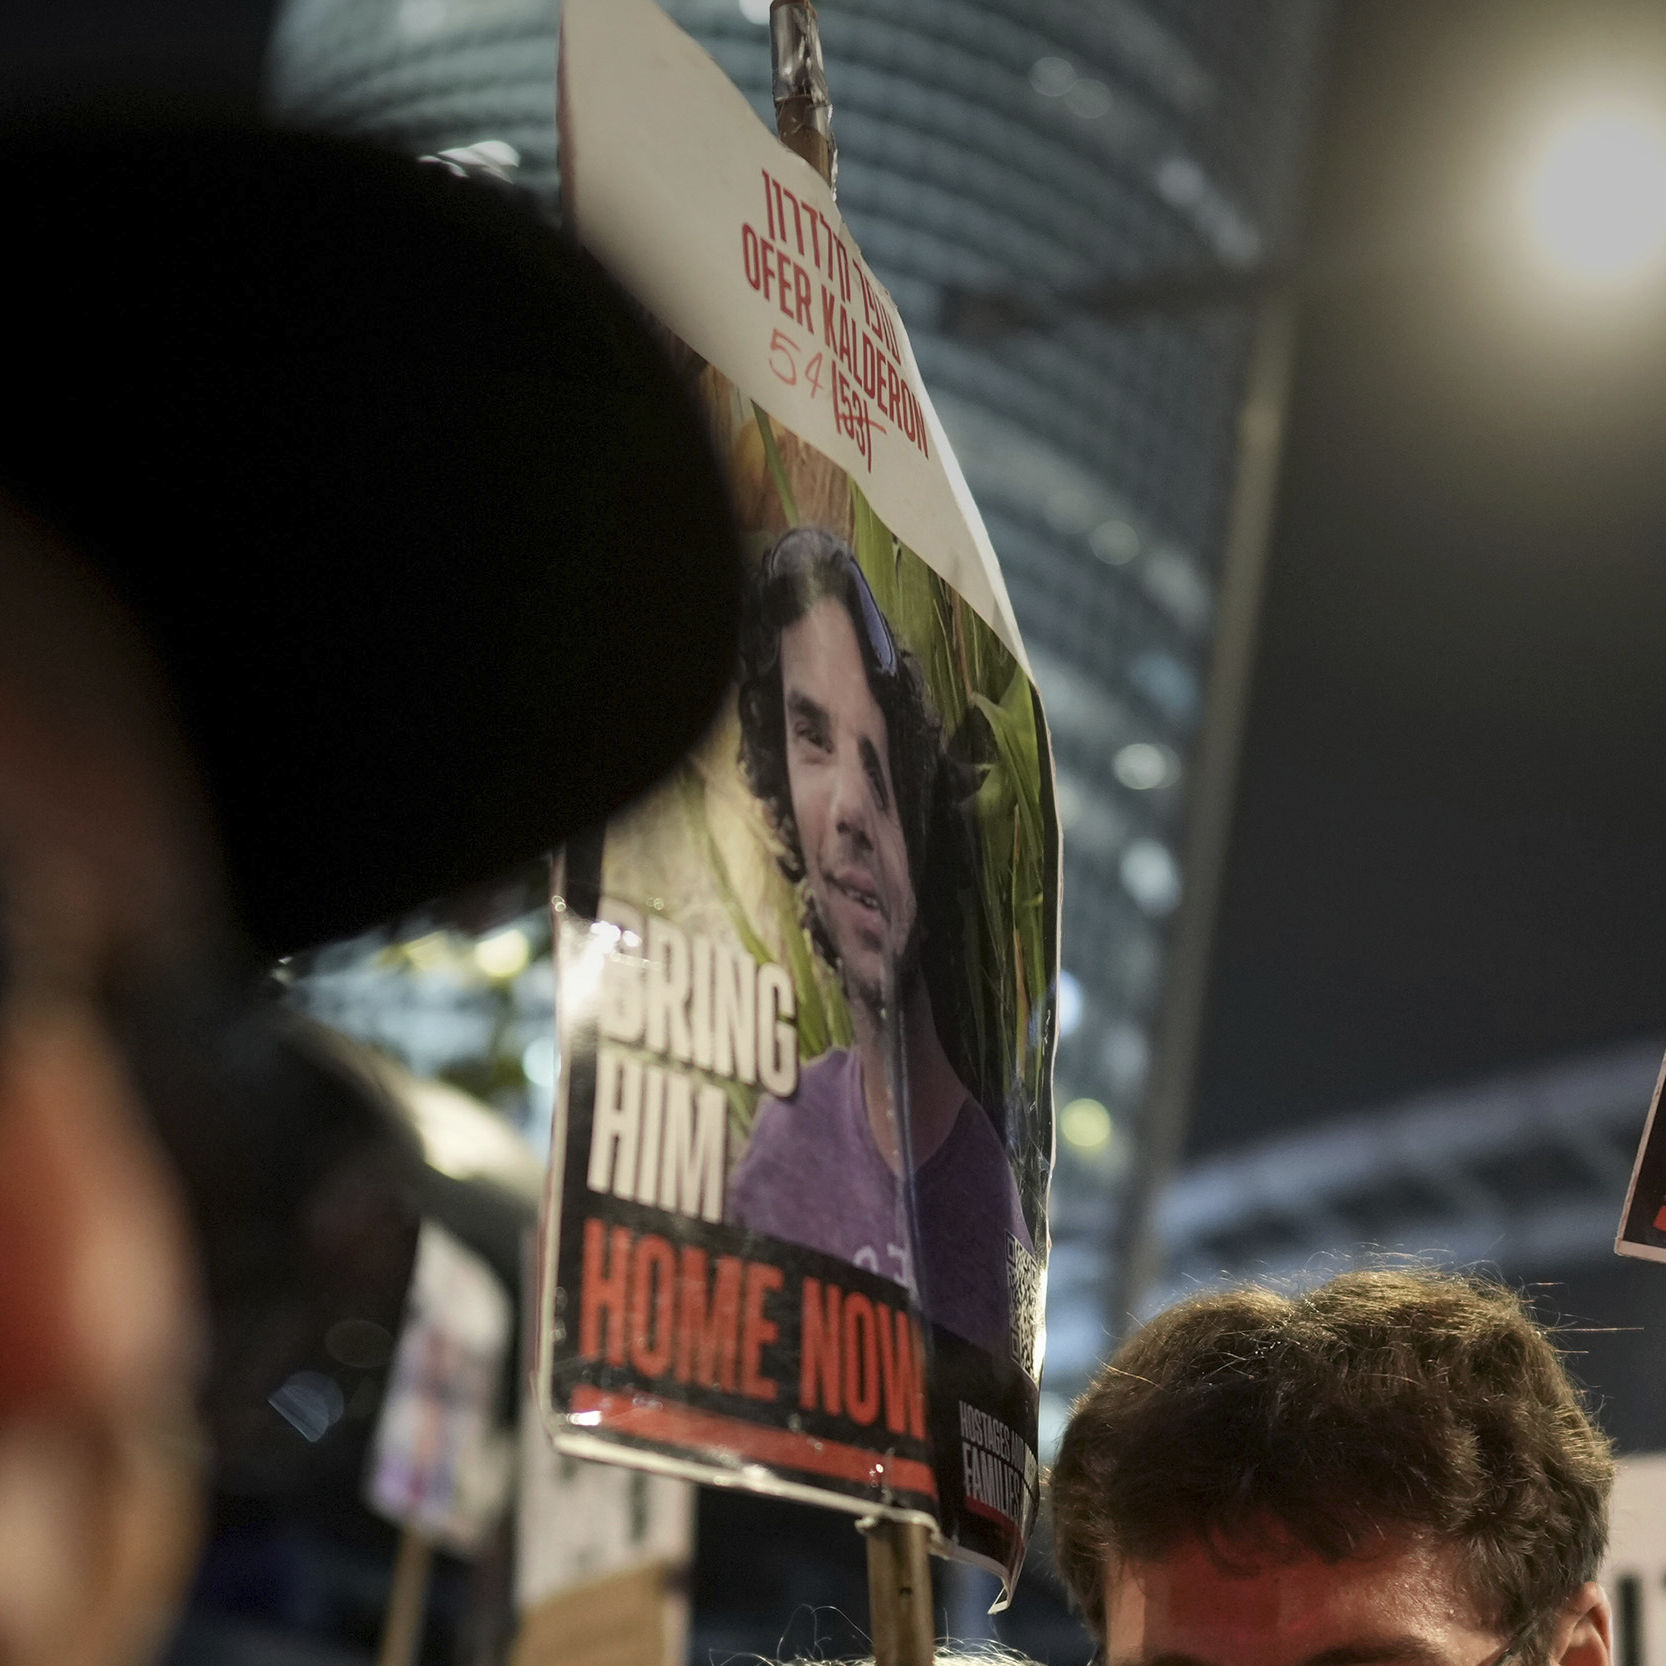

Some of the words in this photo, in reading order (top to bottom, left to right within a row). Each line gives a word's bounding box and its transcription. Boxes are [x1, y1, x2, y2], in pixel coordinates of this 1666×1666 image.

[742, 222, 815, 335] OFER
[821, 284, 929, 460] KALDERON
[769, 328, 825, 400] 54
[597, 897, 800, 1098] BRING
[587, 1043, 728, 1225] HIM
[578, 1217, 783, 1401] HOME
[959, 1399, 1011, 1463] HOSTAGES
